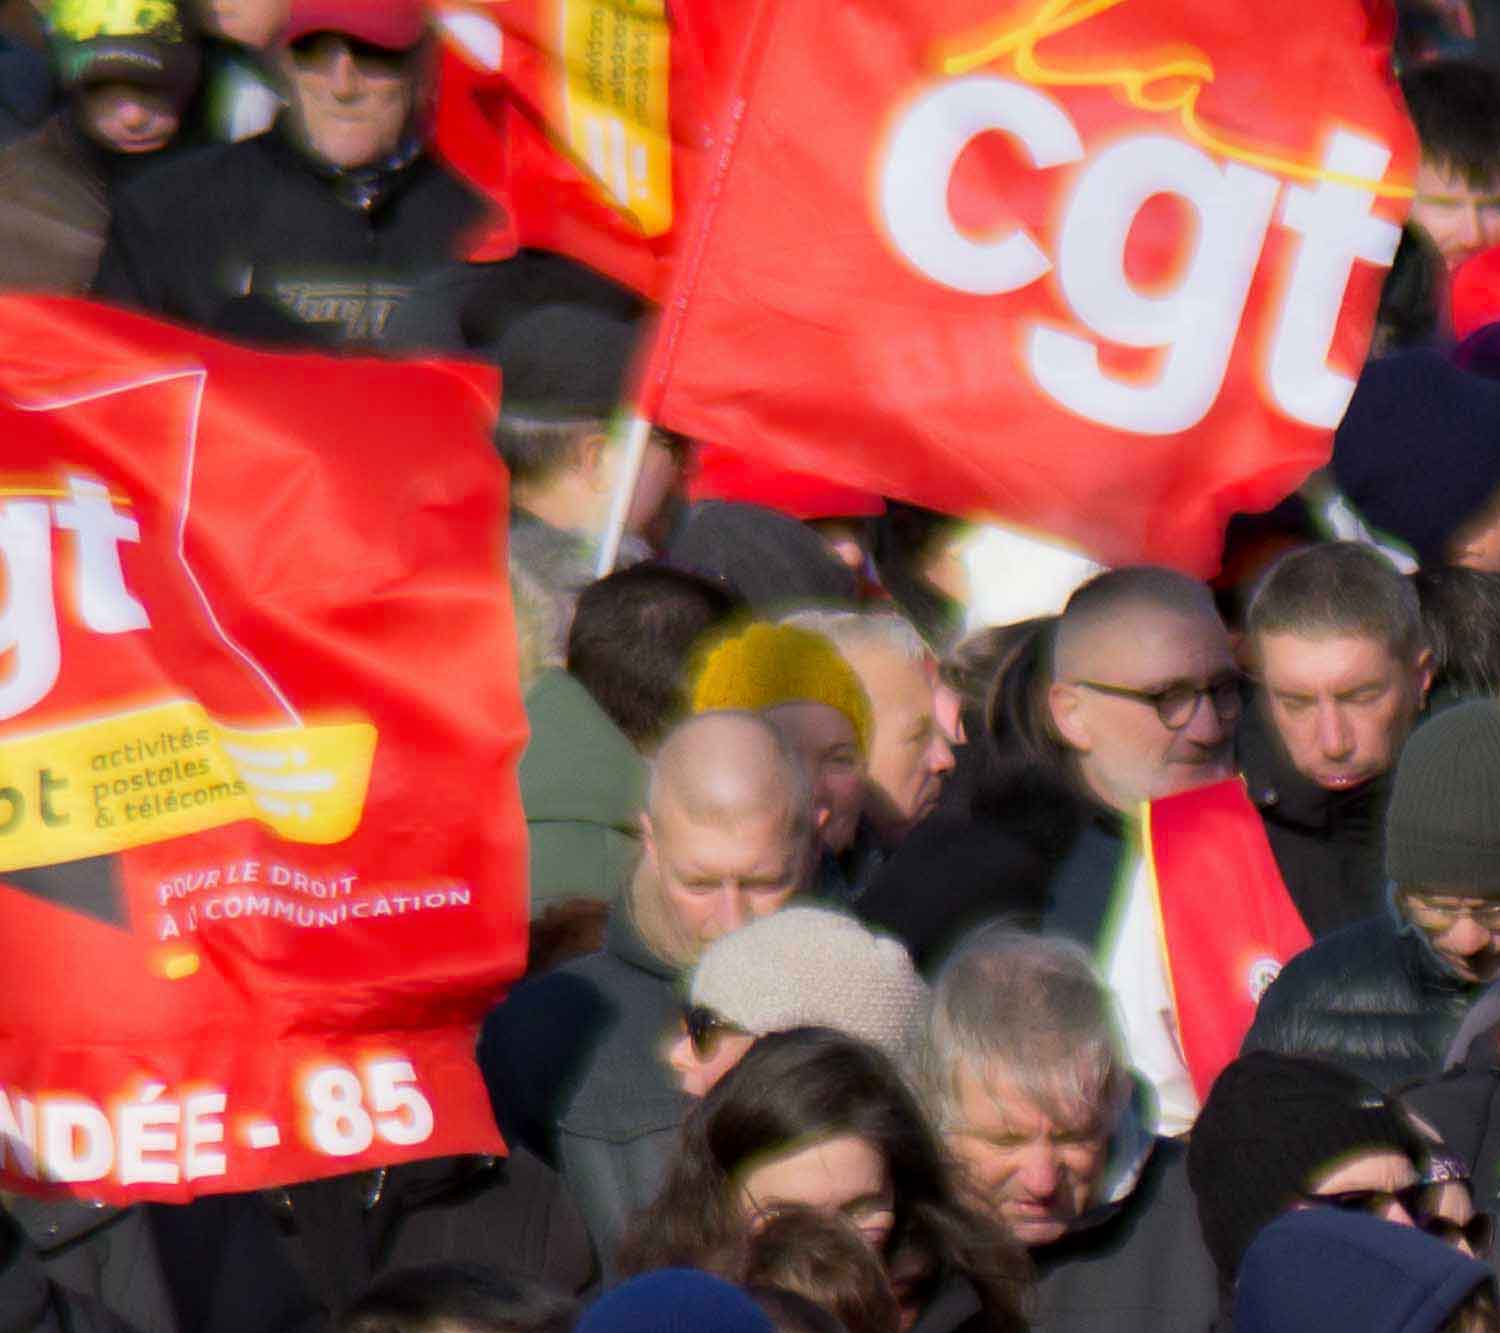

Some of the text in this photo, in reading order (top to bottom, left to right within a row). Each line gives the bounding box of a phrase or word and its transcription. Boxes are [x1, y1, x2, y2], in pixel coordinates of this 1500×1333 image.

[882, 78, 1403, 435] cgt
[90, 724, 211, 772] activités
[93, 755, 212, 808] postales
[93, 776, 248, 831] & télécoms
[158, 860, 359, 908] POUR LE DROIT
[204, 886, 471, 930] COMMUNICATION
[302, 1058, 435, 1158] 85
